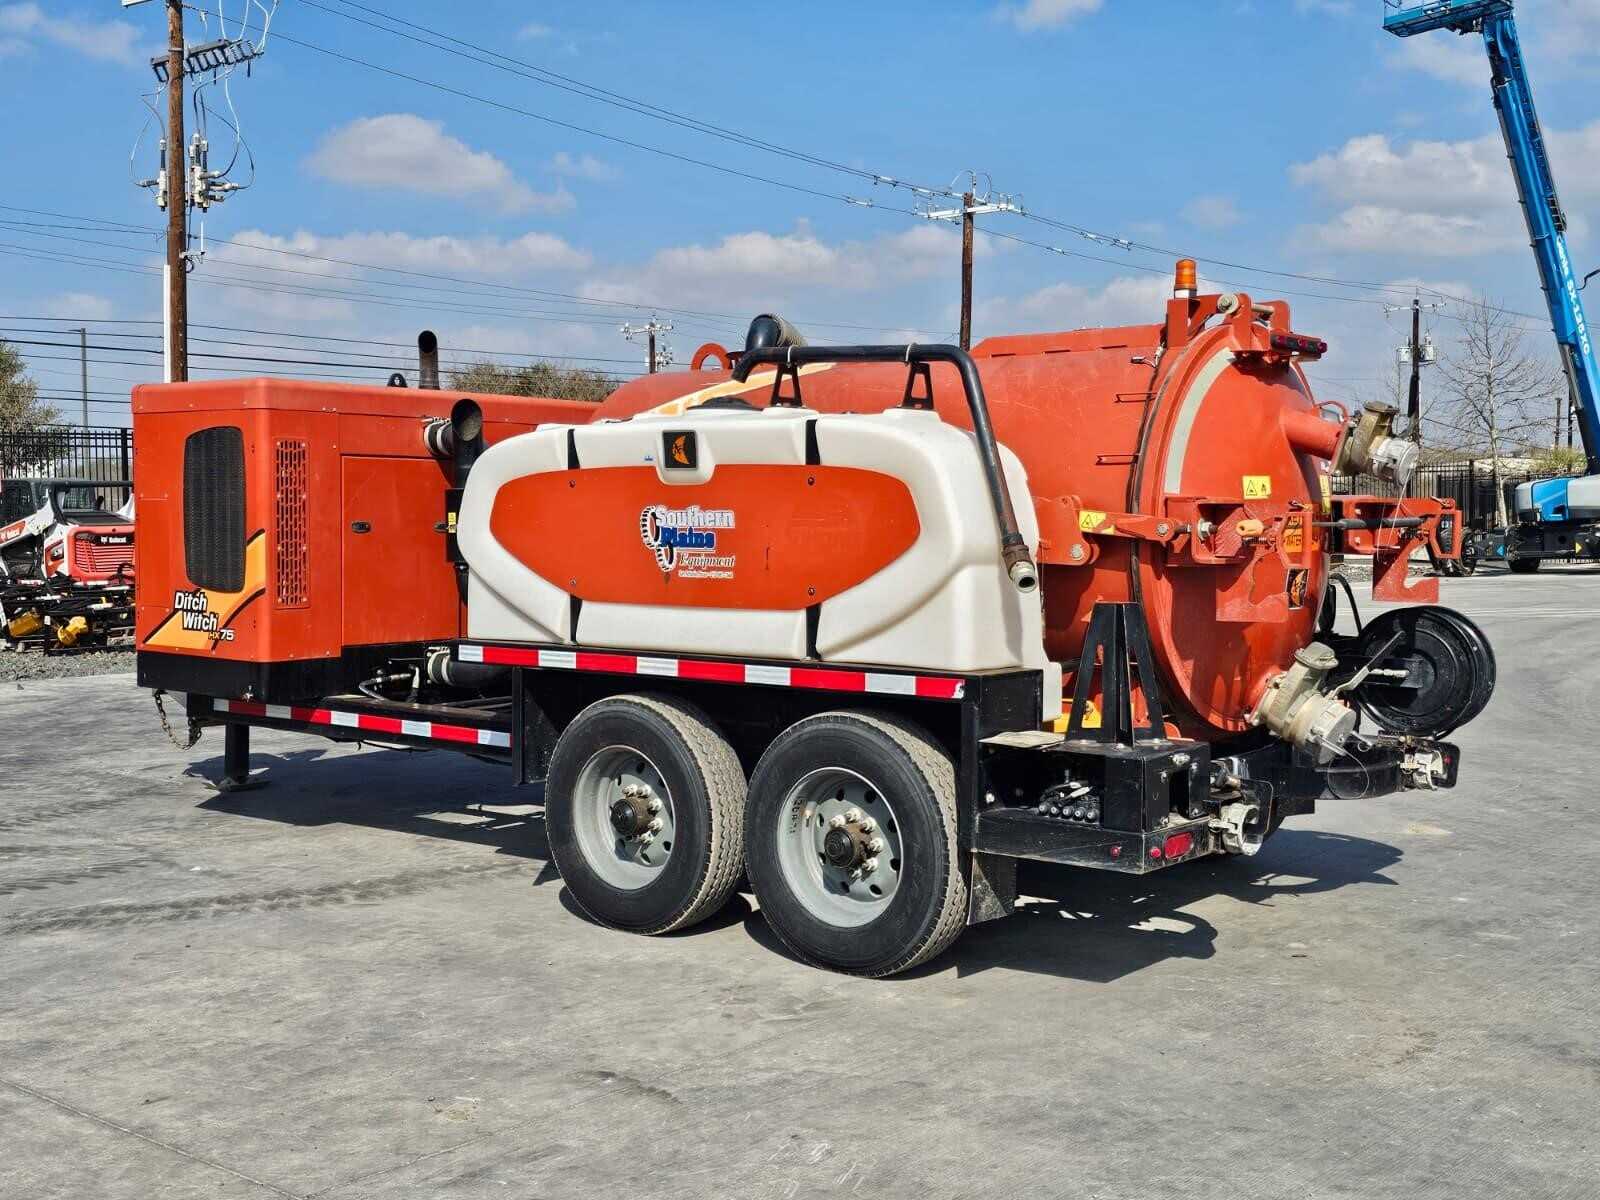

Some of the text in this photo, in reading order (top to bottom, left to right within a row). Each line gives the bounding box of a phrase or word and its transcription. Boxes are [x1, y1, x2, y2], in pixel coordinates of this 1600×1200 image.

[655, 505, 736, 528] Southern
[660, 526, 715, 549] Plains
[679, 553, 736, 570] Equipment
[174, 591, 208, 612] Ditch
[182, 611, 219, 632] Witch
